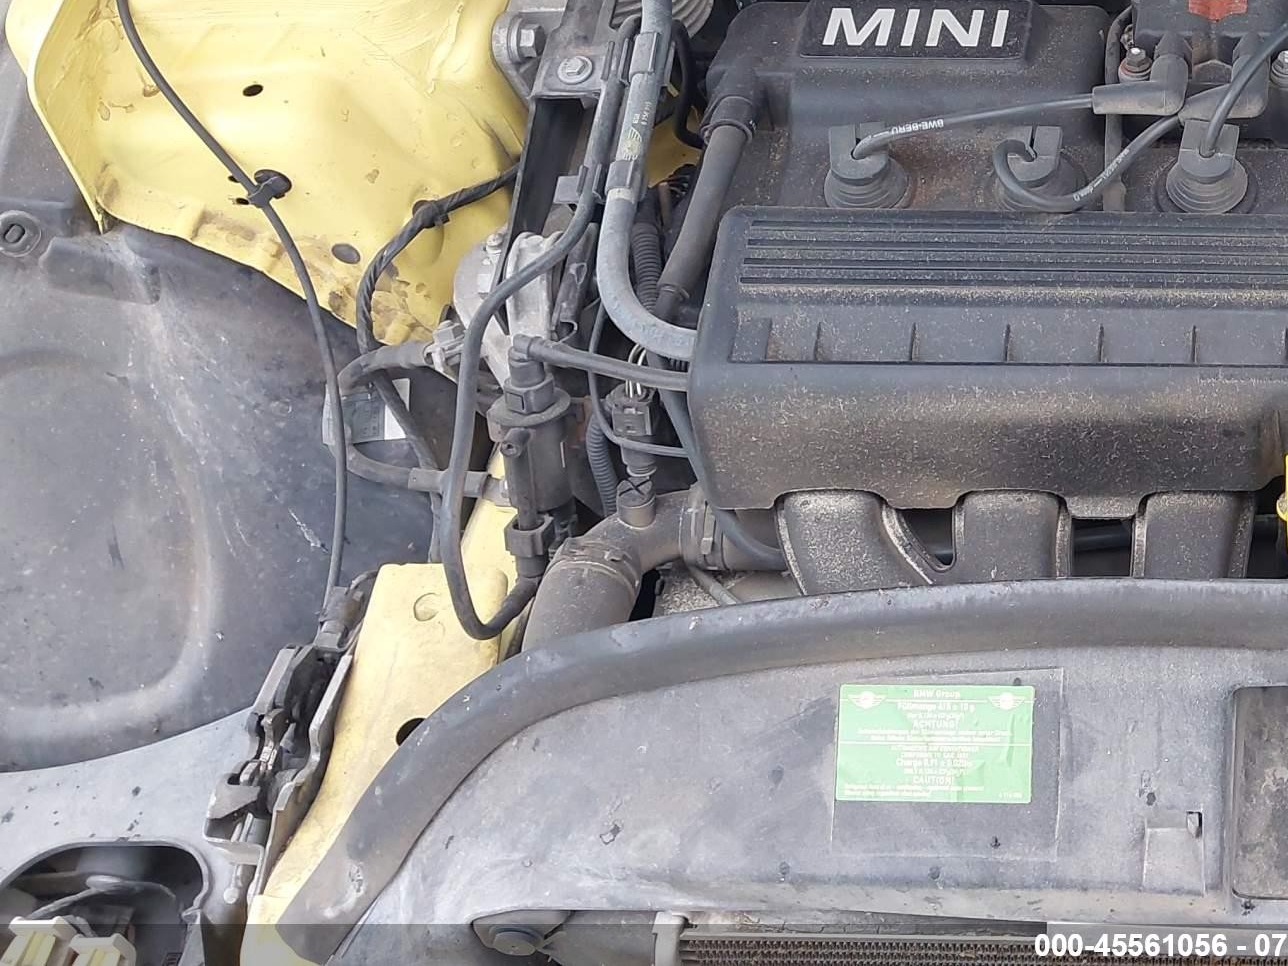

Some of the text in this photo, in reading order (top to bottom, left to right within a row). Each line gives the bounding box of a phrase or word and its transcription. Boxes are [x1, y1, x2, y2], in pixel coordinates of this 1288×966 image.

[822, 7, 1009, 47] MINI
[913, 689, 960, 699] BMW Group
[913, 720, 960, 730] ACHTUNG!
